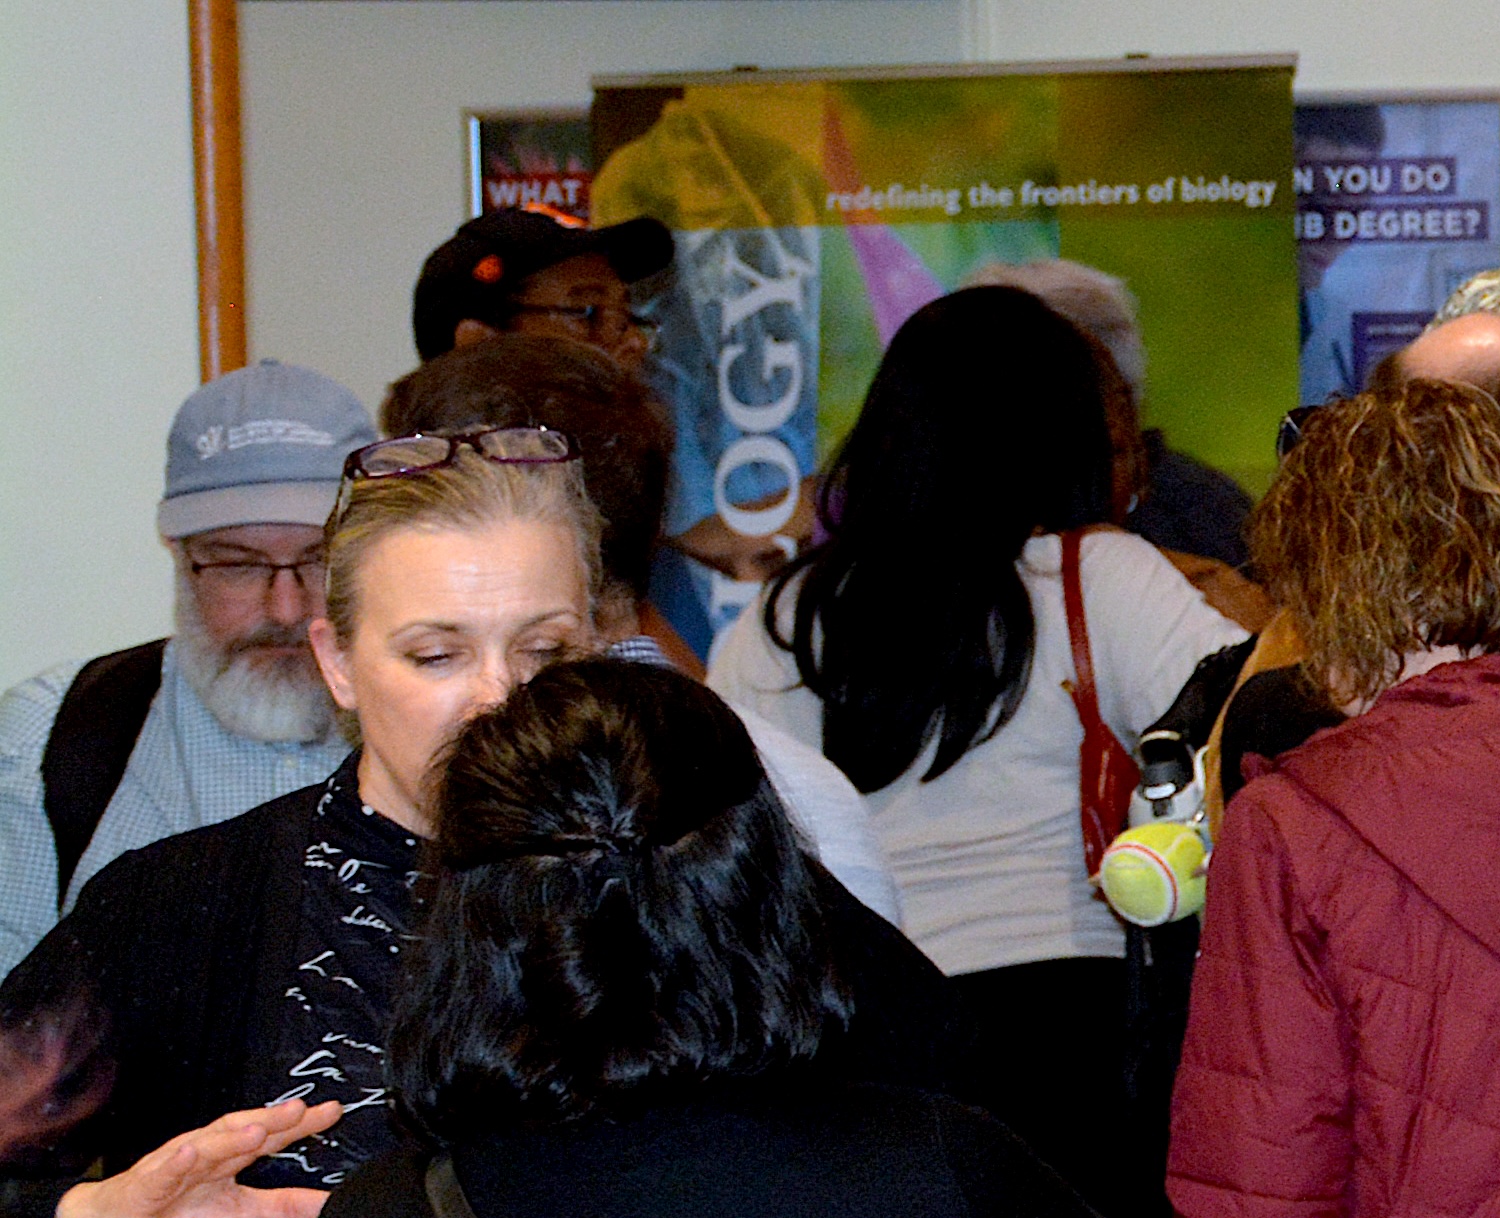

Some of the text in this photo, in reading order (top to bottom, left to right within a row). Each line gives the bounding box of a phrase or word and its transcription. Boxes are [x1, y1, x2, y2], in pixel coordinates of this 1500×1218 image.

[487, 178, 583, 207] WHAT
[1324, 165, 1392, 194] YOU
[1402, 164, 1450, 193] DO
[826, 175, 1277, 216] redefining the frontiers of biology
[1294, 208, 1481, 239] B DEGREE?
